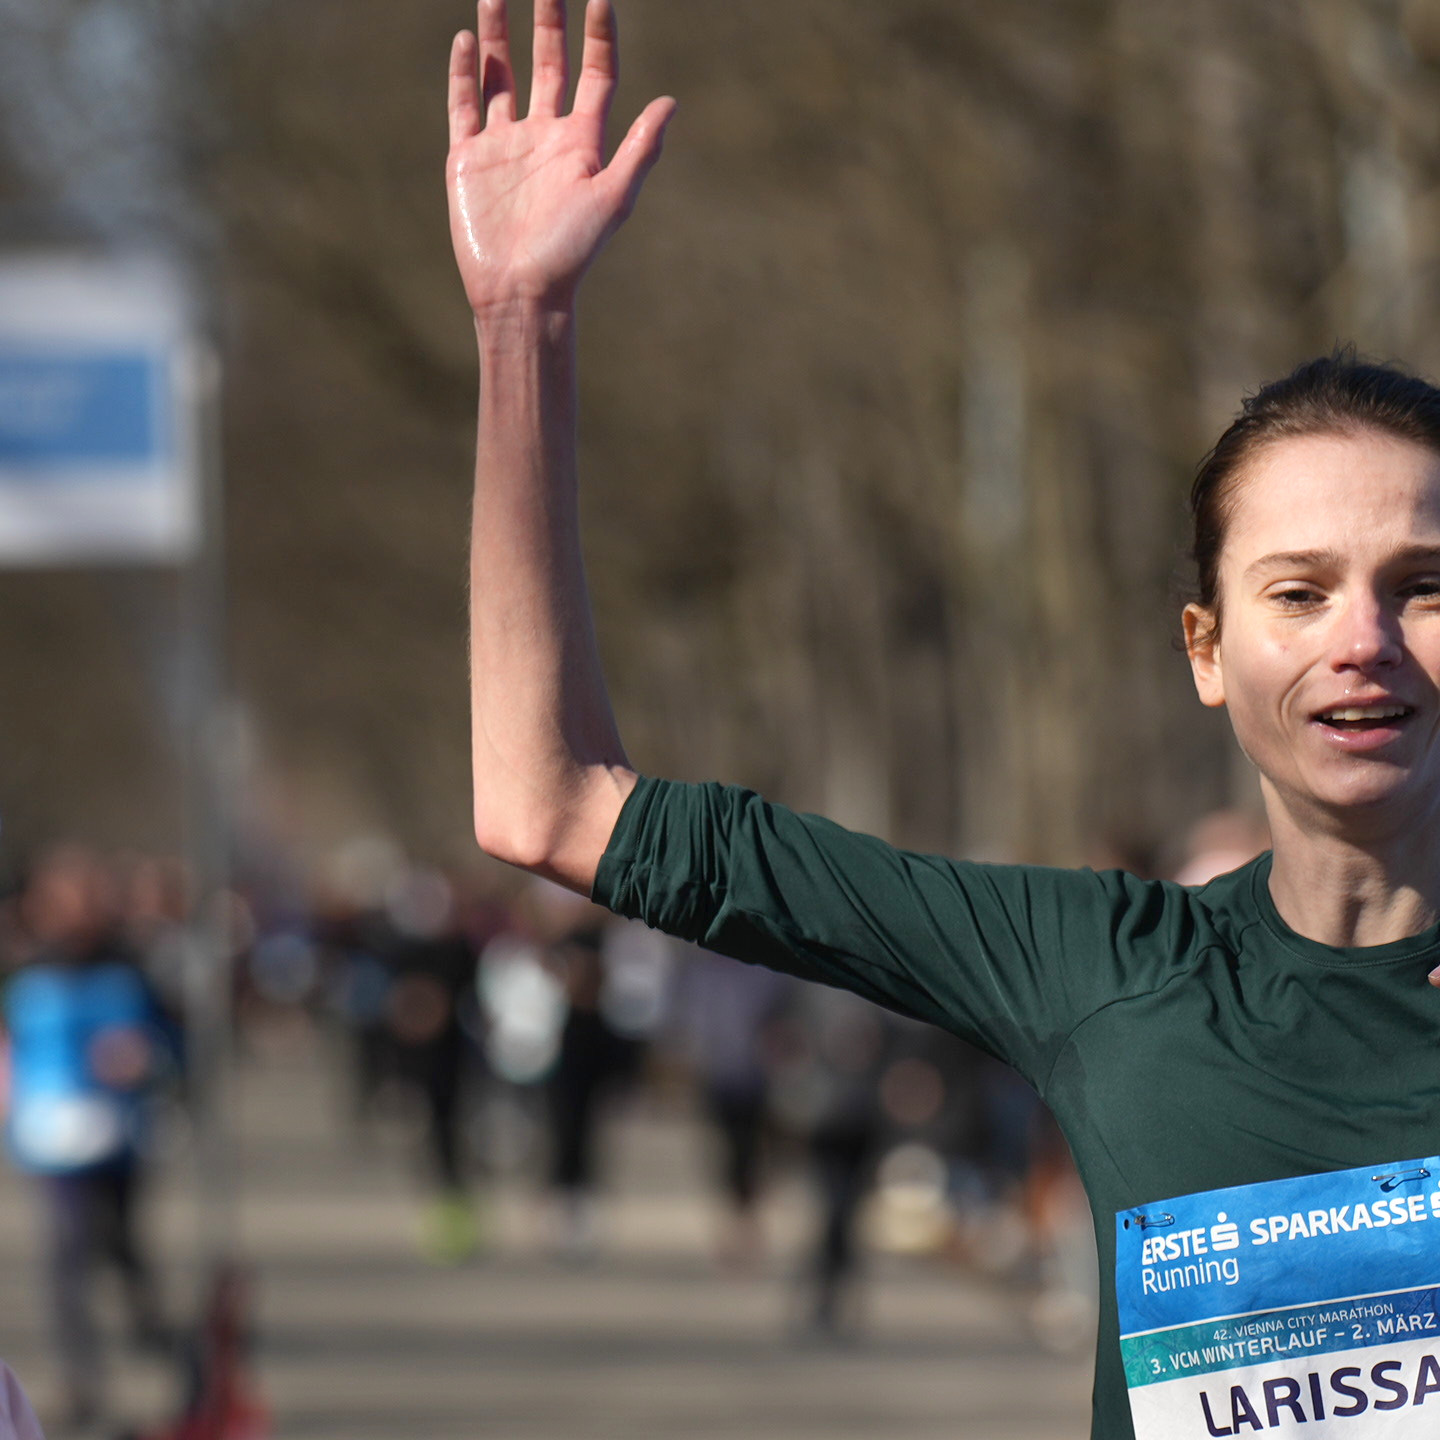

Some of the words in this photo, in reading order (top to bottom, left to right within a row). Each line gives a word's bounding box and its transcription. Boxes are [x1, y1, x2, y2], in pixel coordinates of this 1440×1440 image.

[1141, 1226, 1208, 1267] ERSTE
[1250, 1195, 1427, 1247] SPARKASSE
[1141, 1258, 1240, 1295] Running
[1150, 1358, 1167, 1374] 3.
[1169, 1348, 1200, 1370] VCM
[1202, 1328, 1328, 1366] WINTERLAUF
[1352, 1324, 1371, 1341] 2.
[1376, 1313, 1436, 1336] MÄRZ
[1213, 1327, 1233, 1341] 42.
[1235, 1319, 1285, 1338] VIENNA
[1287, 1314, 1316, 1331] CITY
[1319, 1303, 1394, 1323] MARATHON
